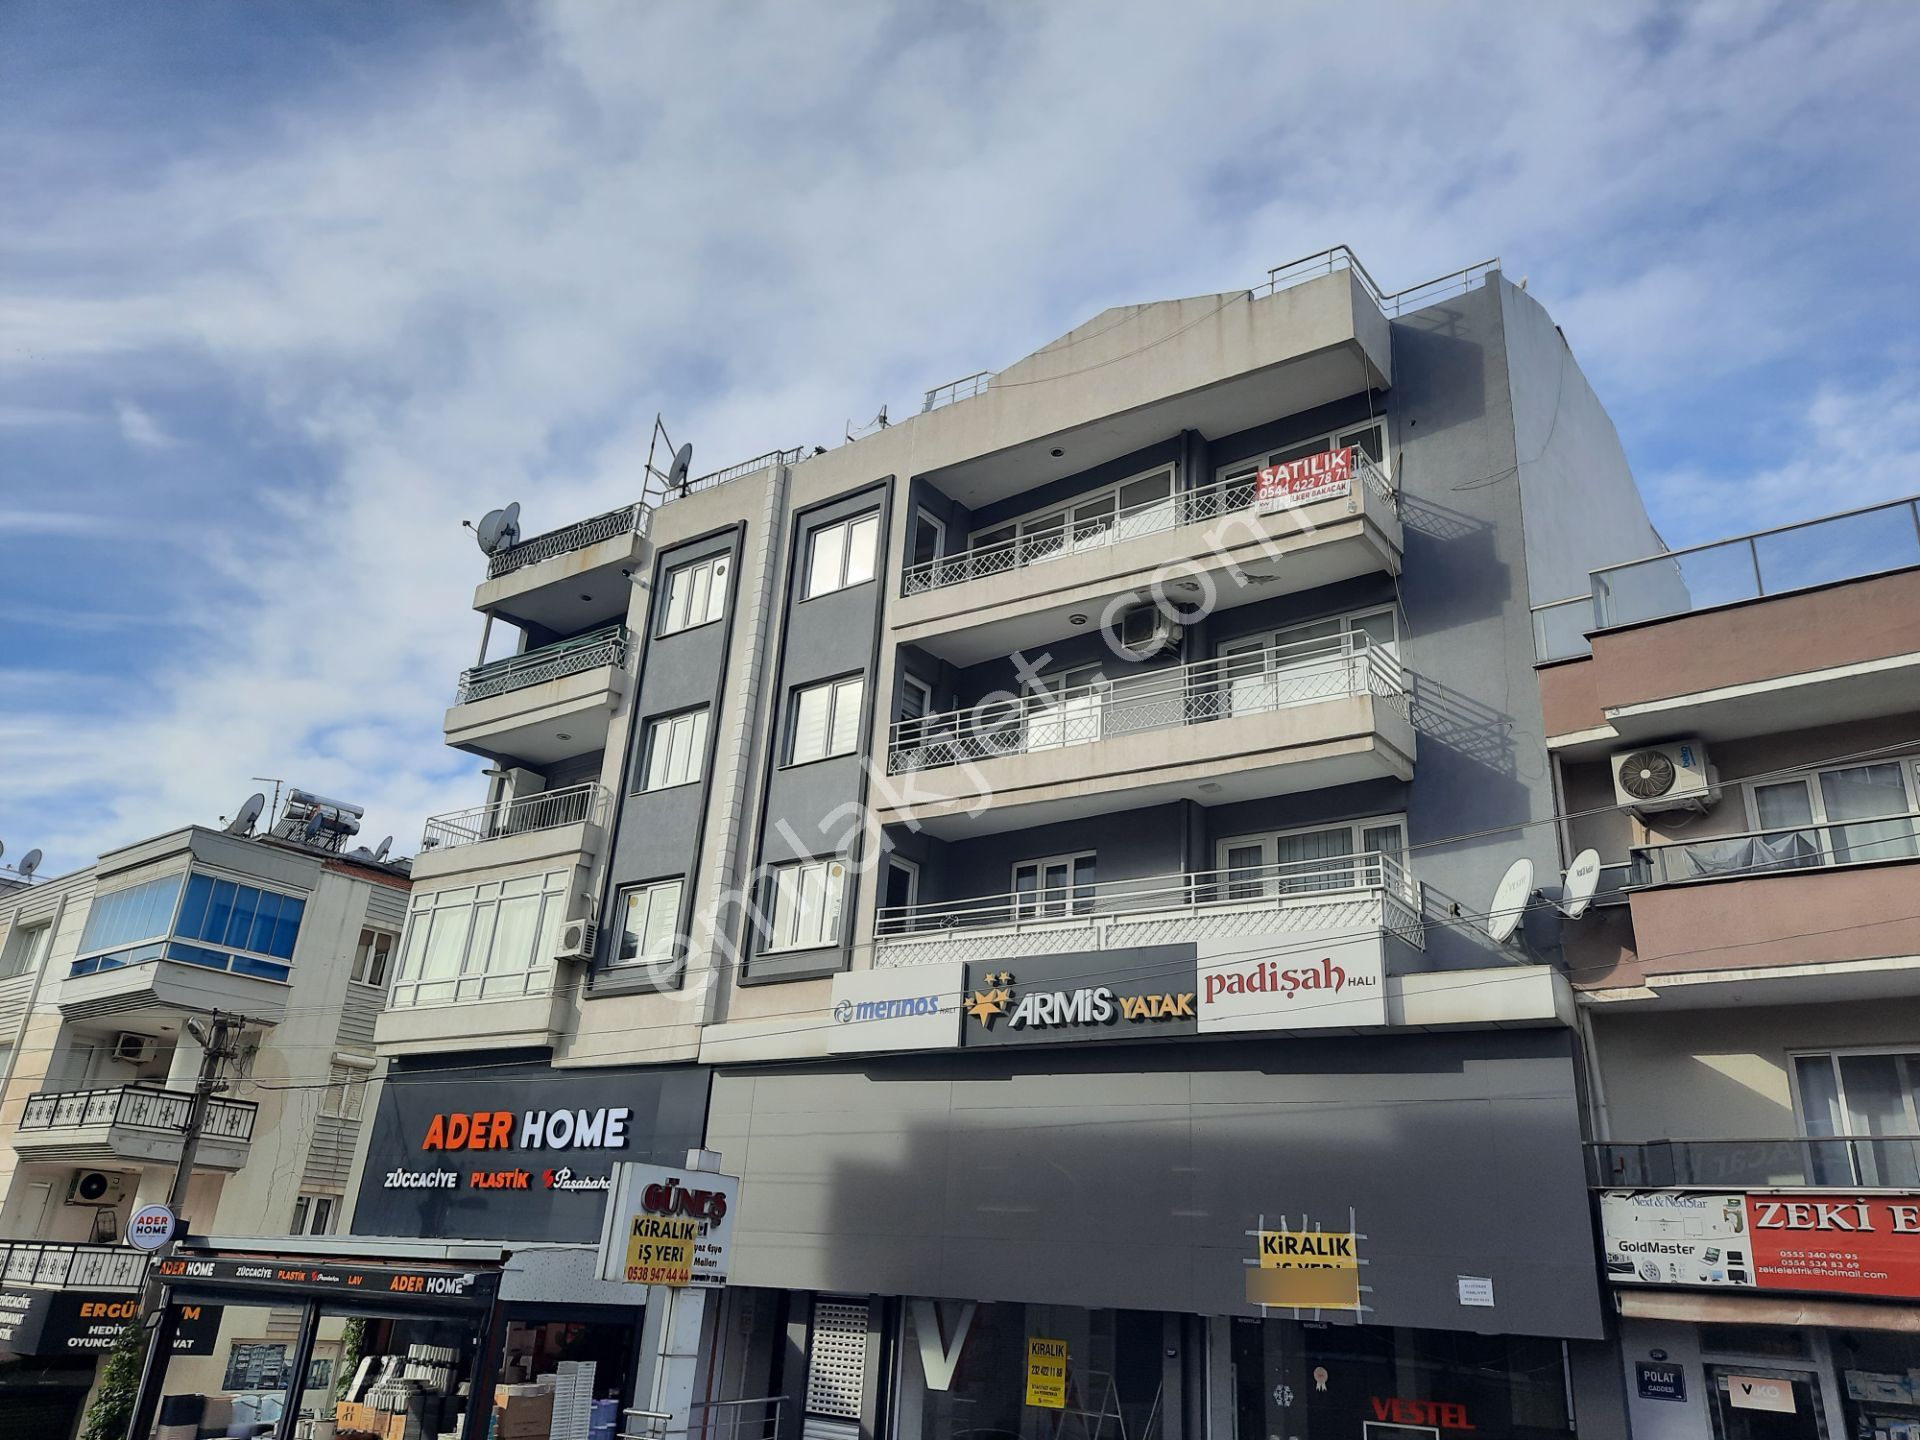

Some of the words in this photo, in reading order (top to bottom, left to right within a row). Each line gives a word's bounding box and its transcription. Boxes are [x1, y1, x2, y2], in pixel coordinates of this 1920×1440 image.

[1262, 450, 1346, 486] SATILIK
[1260, 485, 1290, 498] 0544
[1293, 477, 1315, 492] 422
[1318, 471, 1332, 486] 78
[1336, 467, 1347, 480] 71
[1680, 746, 1691, 768] beko
[1205, 957, 1346, 1004] padişah
[1348, 976, 1376, 987] HALI
[856, 997, 939, 1021] merinos
[1120, 992, 1196, 1020] YATAK
[421, 1112, 513, 1149] ADER
[520, 1108, 629, 1149] HOME
[384, 1168, 458, 1189] ZÜCCACİYE
[470, 1167, 530, 1188] PLASTİK
[641, 1178, 727, 1229] GÜNEŞ
[1755, 1198, 1876, 1231] ZEKİ
[136, 1225, 168, 1234] HOME
[137, 1216, 168, 1225] ADER
[1618, 1240, 1696, 1255] GoldMaster
[159, 1261, 187, 1275] ADER
[186, 1262, 215, 1277] HOME
[236, 1265, 272, 1278] ZÜCCACİYE
[348, 1275, 363, 1285] LAV
[390, 1275, 424, 1292] ADER
[426, 1277, 463, 1294] HOME
[627, 1266, 648, 1281] 0538
[650, 1267, 665, 1281] 947
[666, 1268, 678, 1282] 44
[679, 1269, 689, 1283] 44
[80, 1301, 143, 1318] ERGÜ
[1643, 1370, 1675, 1384] POLAT
[1370, 1395, 1476, 1429] VESTEL
